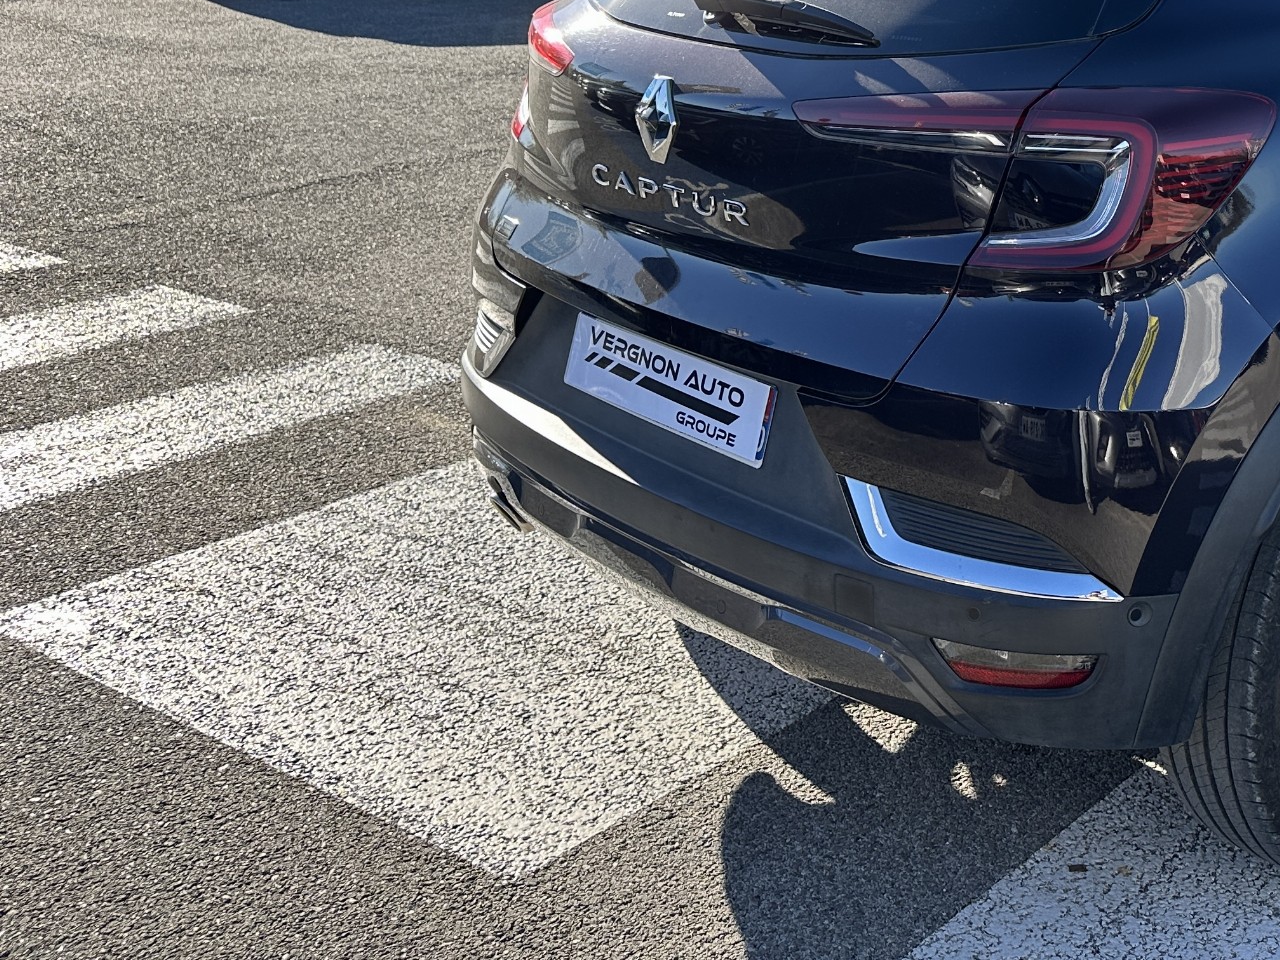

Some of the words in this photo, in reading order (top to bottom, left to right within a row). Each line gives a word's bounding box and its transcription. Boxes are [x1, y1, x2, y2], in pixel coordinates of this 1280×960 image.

[591, 163, 750, 226] CAPTUR
[591, 325, 681, 382] VERGNON
[683, 369, 745, 408] AUTO
[675, 410, 737, 448] GROUPE
